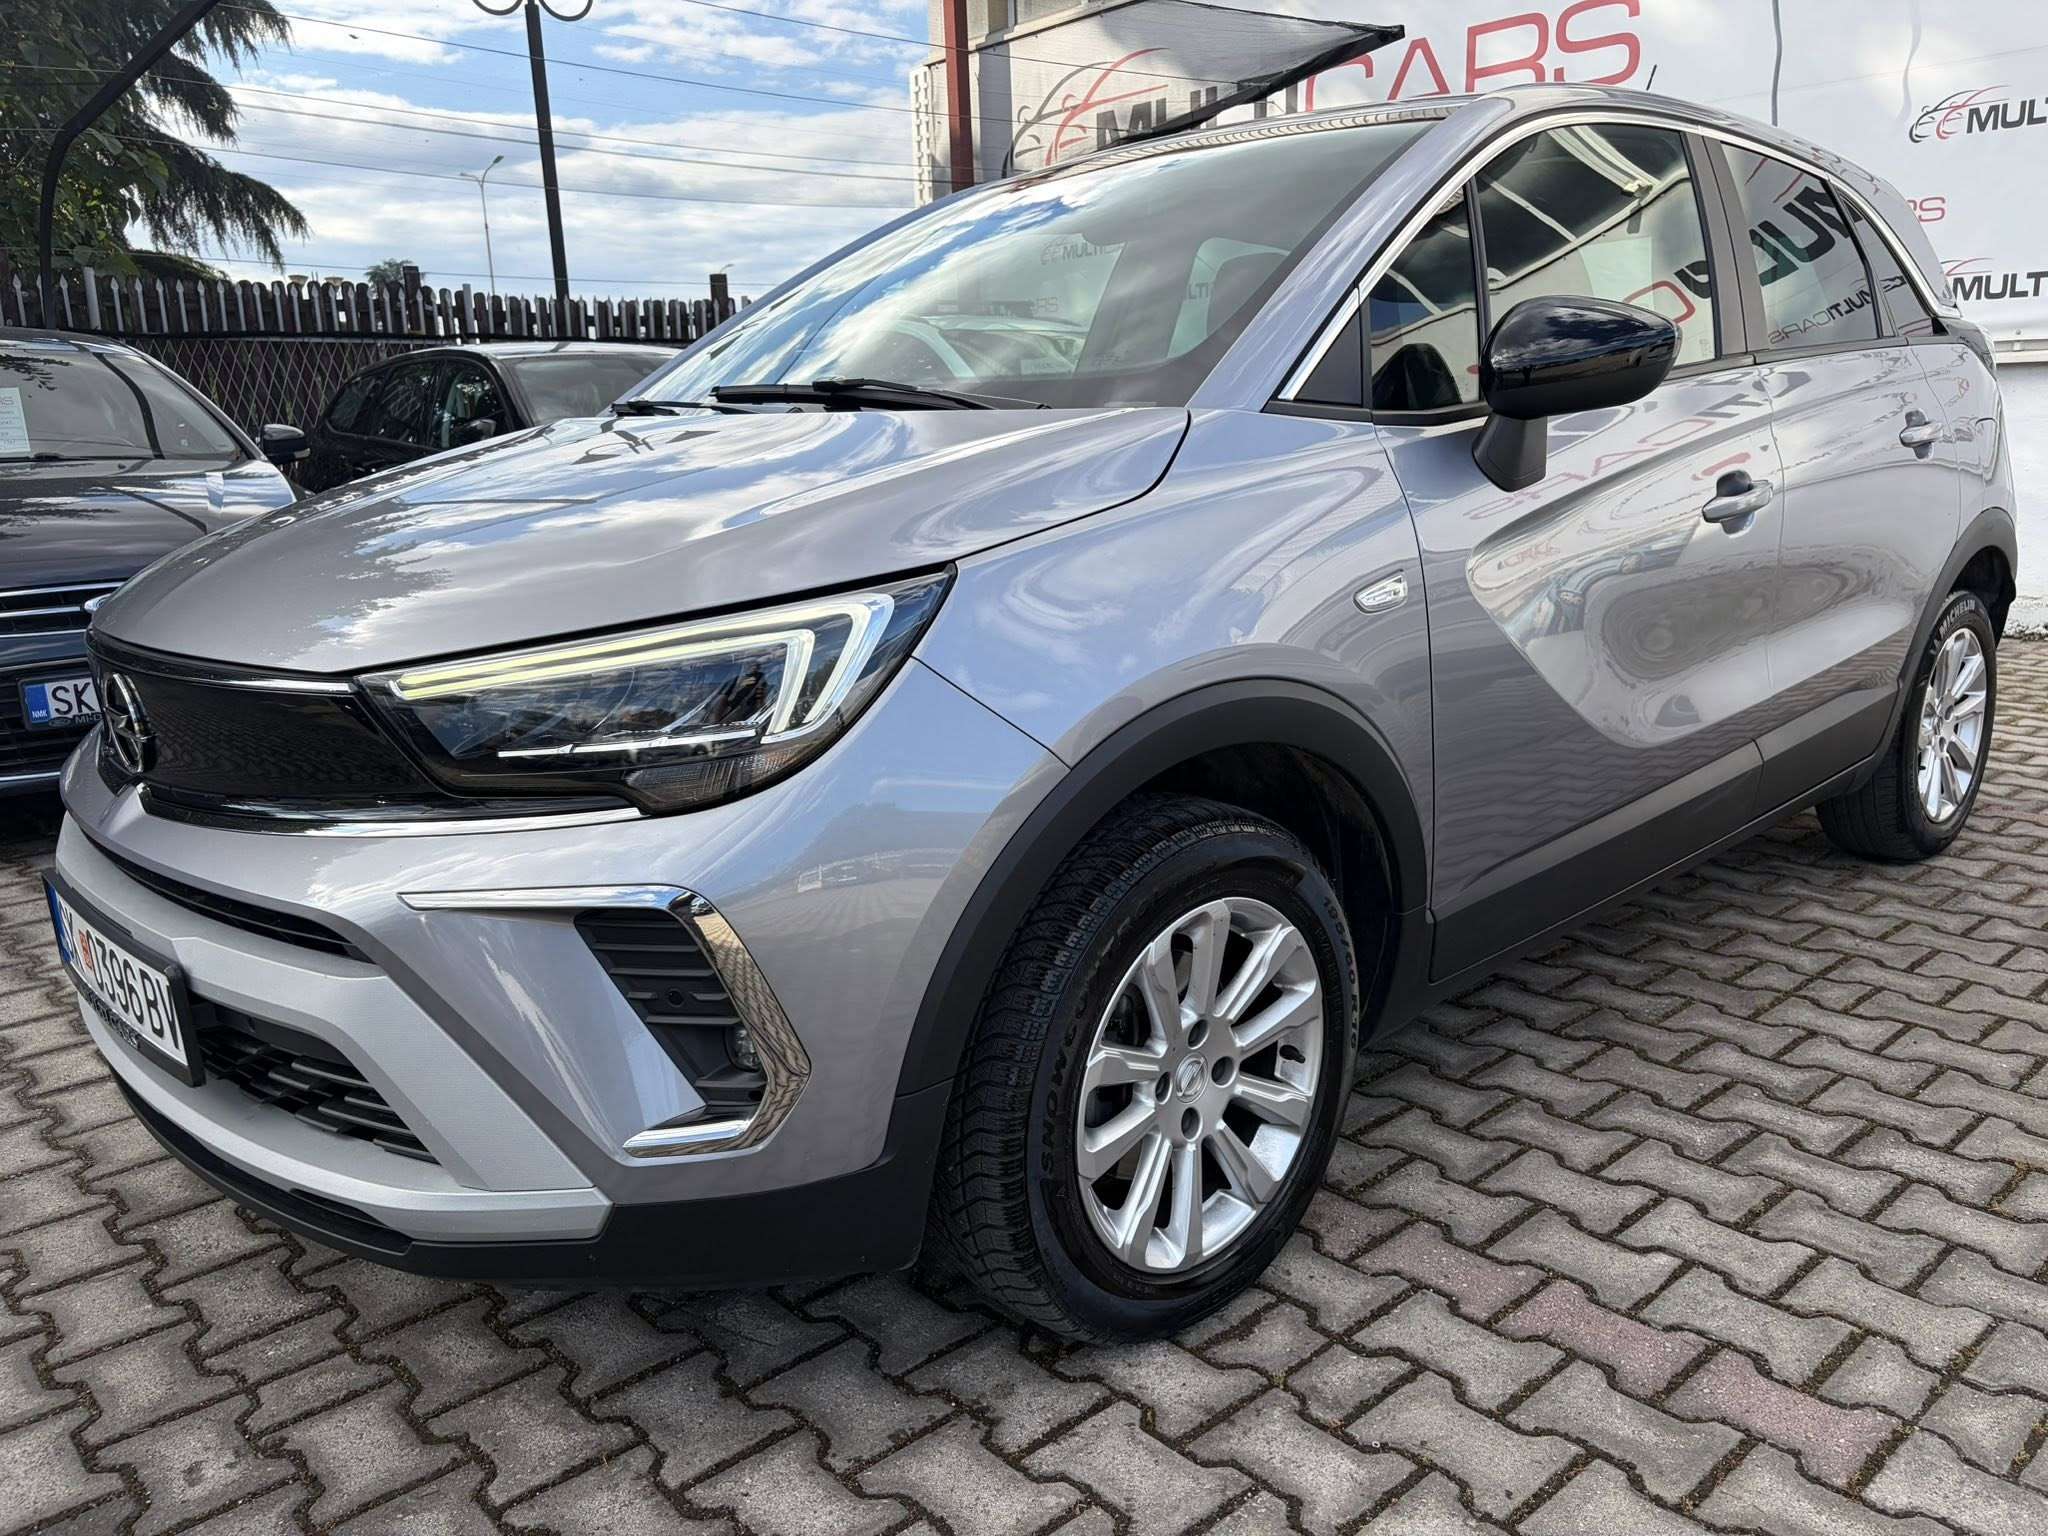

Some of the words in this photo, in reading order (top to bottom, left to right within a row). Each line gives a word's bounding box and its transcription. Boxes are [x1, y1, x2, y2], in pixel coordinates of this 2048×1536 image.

[1967, 97, 2048, 133] MUL
[51, 682, 96, 715] SK
[138, 966, 180, 1051] BV
